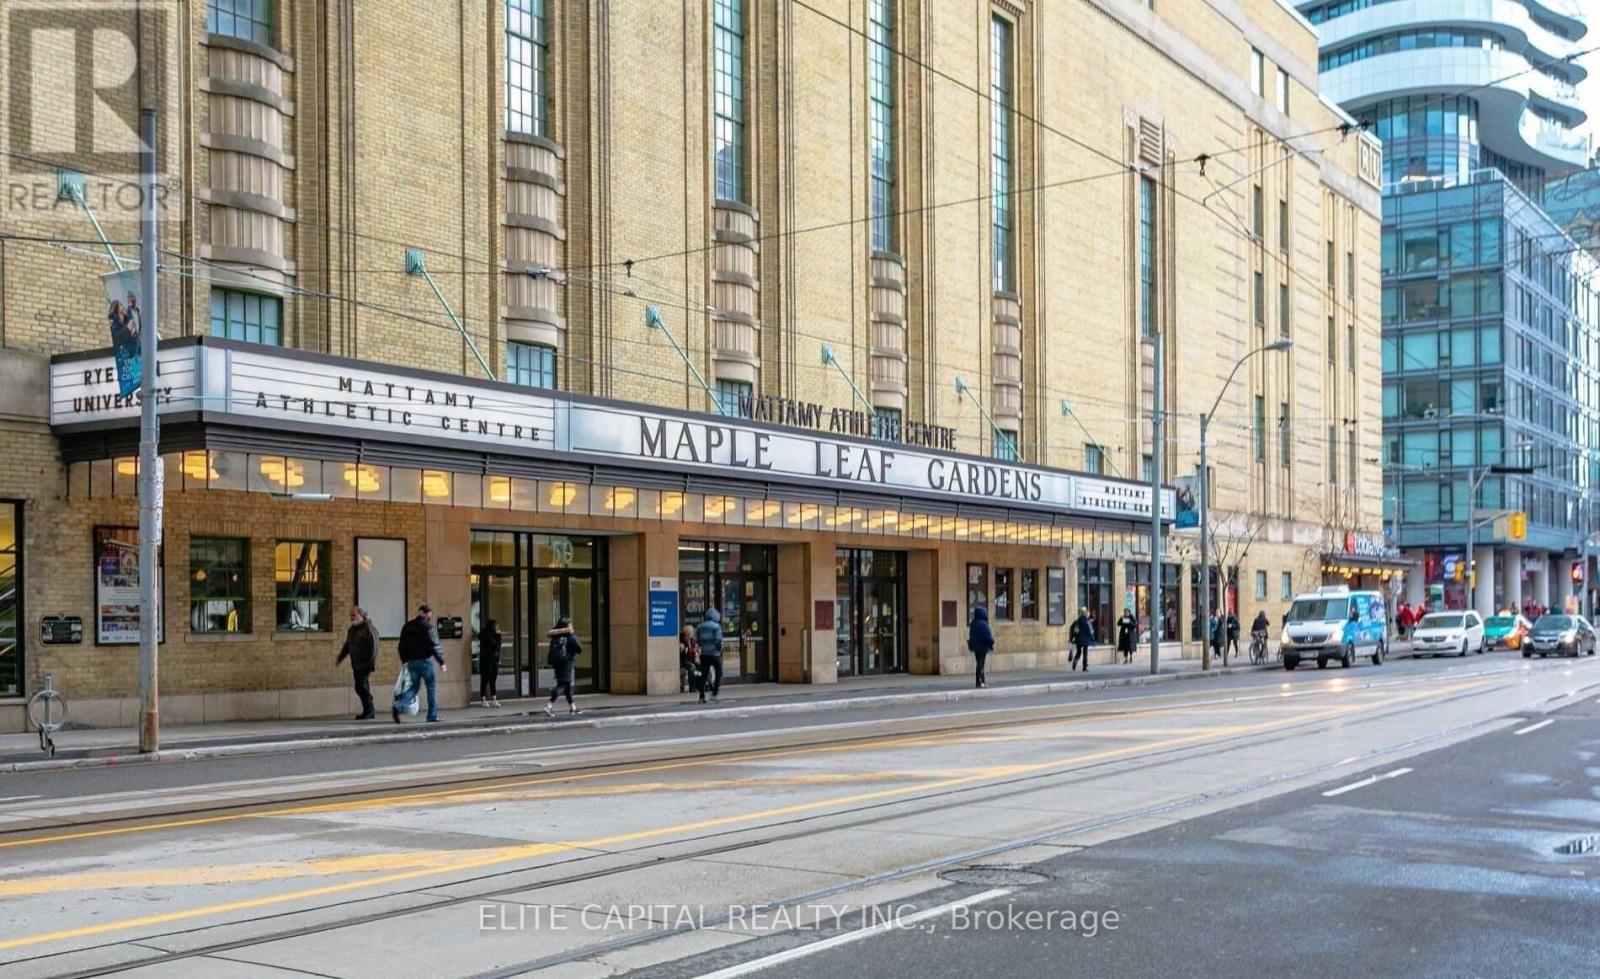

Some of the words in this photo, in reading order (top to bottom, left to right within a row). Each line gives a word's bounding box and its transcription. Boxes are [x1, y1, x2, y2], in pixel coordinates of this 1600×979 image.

[256, 391, 412, 426] ATHLETIC
[441, 416, 540, 441] CENTRE
[339, 376, 476, 409] MATTAMY
[738, 395, 824, 429] MATTAMY
[829, 408, 899, 442] ATHLETIC
[905, 420, 957, 451] CENTRE
[640, 416, 772, 470] MAPLE
[815, 441, 895, 483] LEAF
[928, 458, 1042, 501] GARDENS
